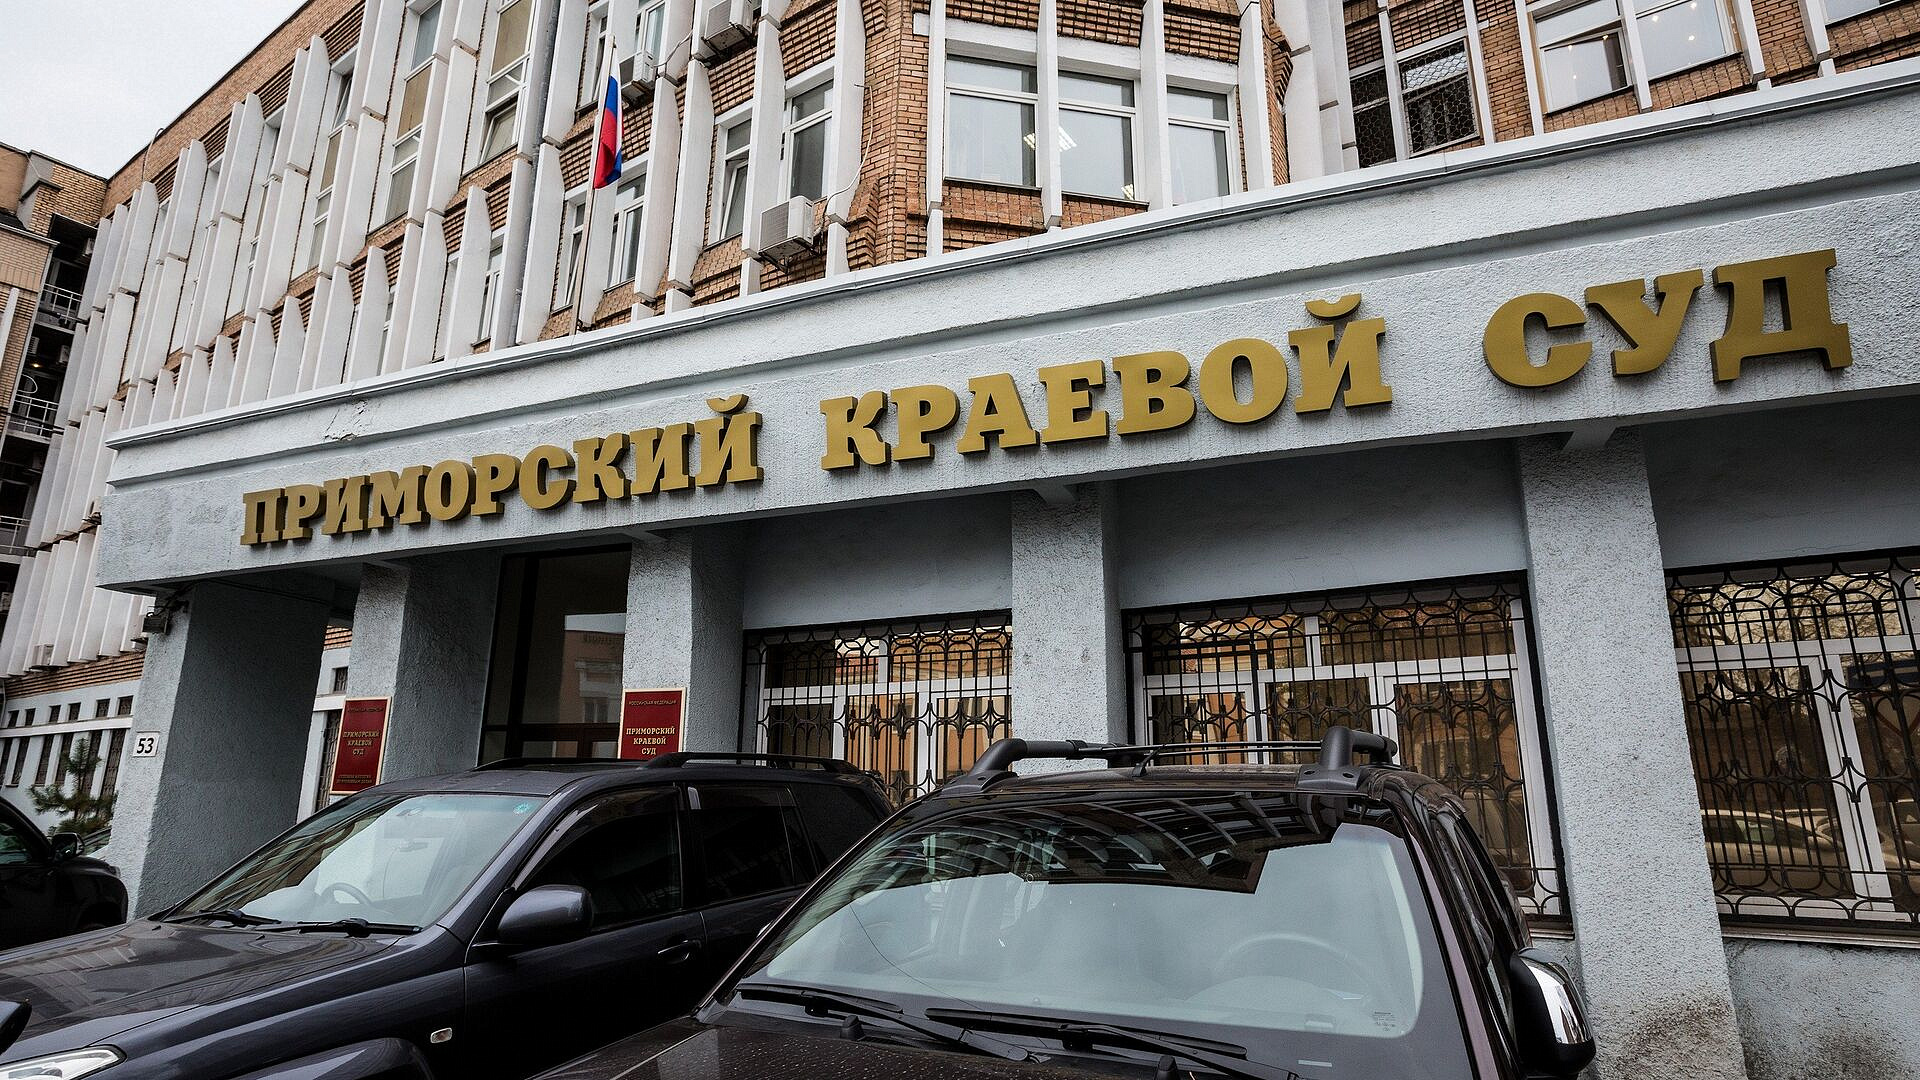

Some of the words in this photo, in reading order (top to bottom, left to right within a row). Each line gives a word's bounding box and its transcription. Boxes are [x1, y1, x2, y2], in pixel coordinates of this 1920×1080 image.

[240, 394, 764, 546] ПРИМОРСКИЙ
[820, 293, 1393, 470] КРАЕВОЙ
[1483, 248, 1853, 388] СУД
[626, 726, 675, 735] ПРИМОРСКИЙ
[633, 736, 667, 745] КРАЕВОЙ
[136, 737, 155, 754] 53
[641, 747, 657, 755] СУД
